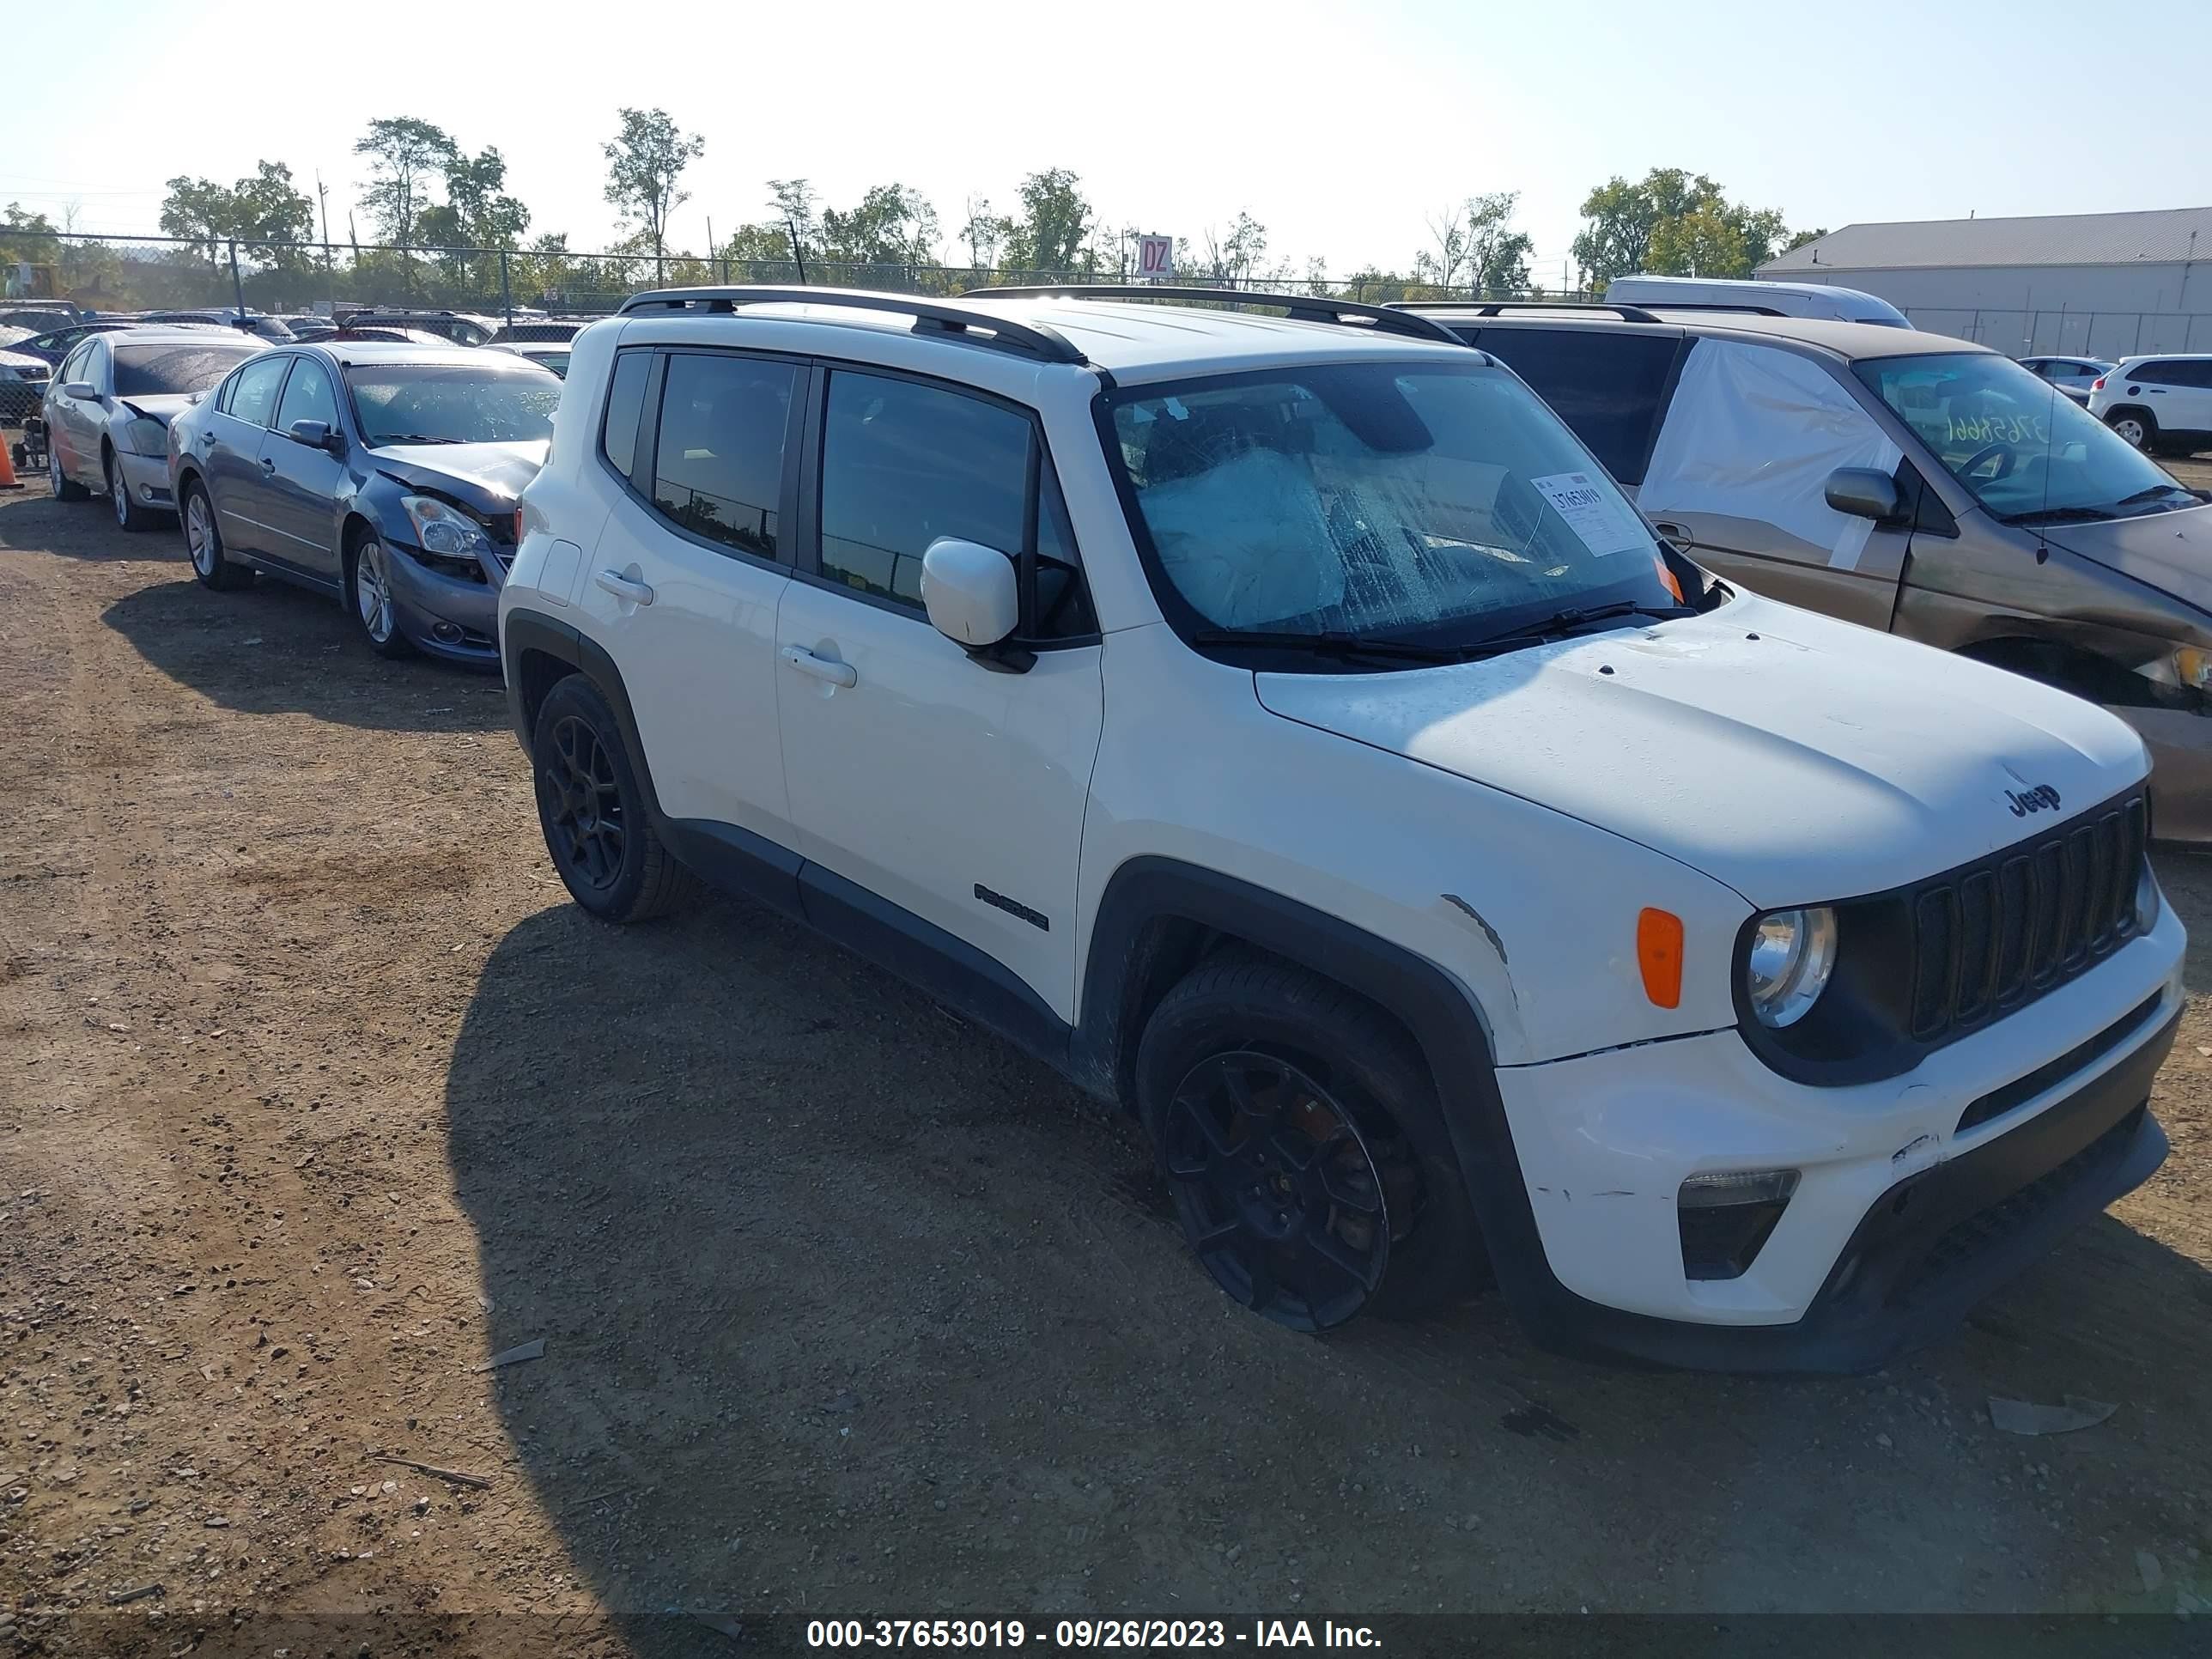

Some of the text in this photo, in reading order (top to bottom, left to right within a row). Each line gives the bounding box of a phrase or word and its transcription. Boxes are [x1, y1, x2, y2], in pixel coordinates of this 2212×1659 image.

[1144, 240, 1167, 272] DZ
[1552, 488, 1601, 509] 37653019
[2003, 784, 2061, 818] Jeep
